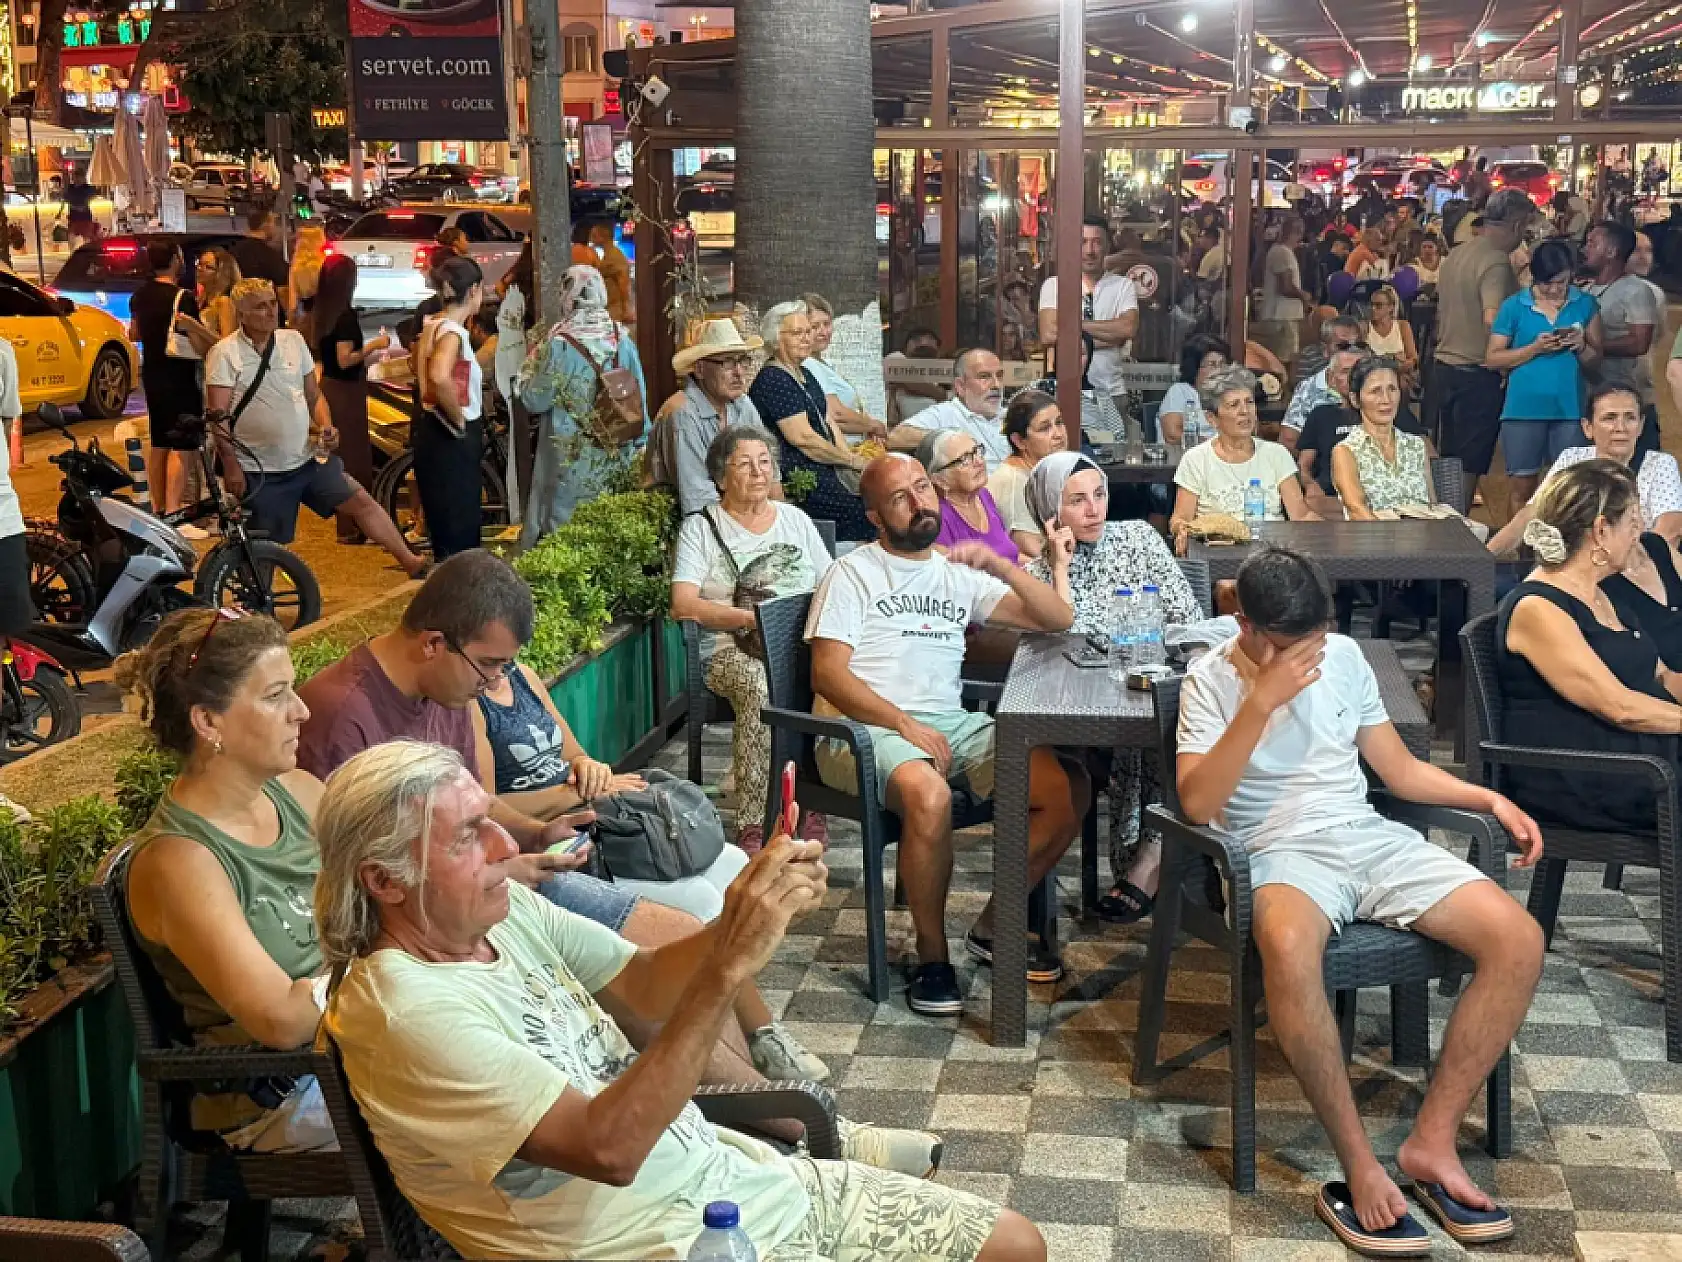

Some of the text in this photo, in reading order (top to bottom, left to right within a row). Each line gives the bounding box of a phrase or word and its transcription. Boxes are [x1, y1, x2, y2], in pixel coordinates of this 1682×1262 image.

[362, 56, 492, 76] servet.com
[374, 97, 494, 110] FETHİYE GÖCEK
[312, 111, 345, 127] TAXI
